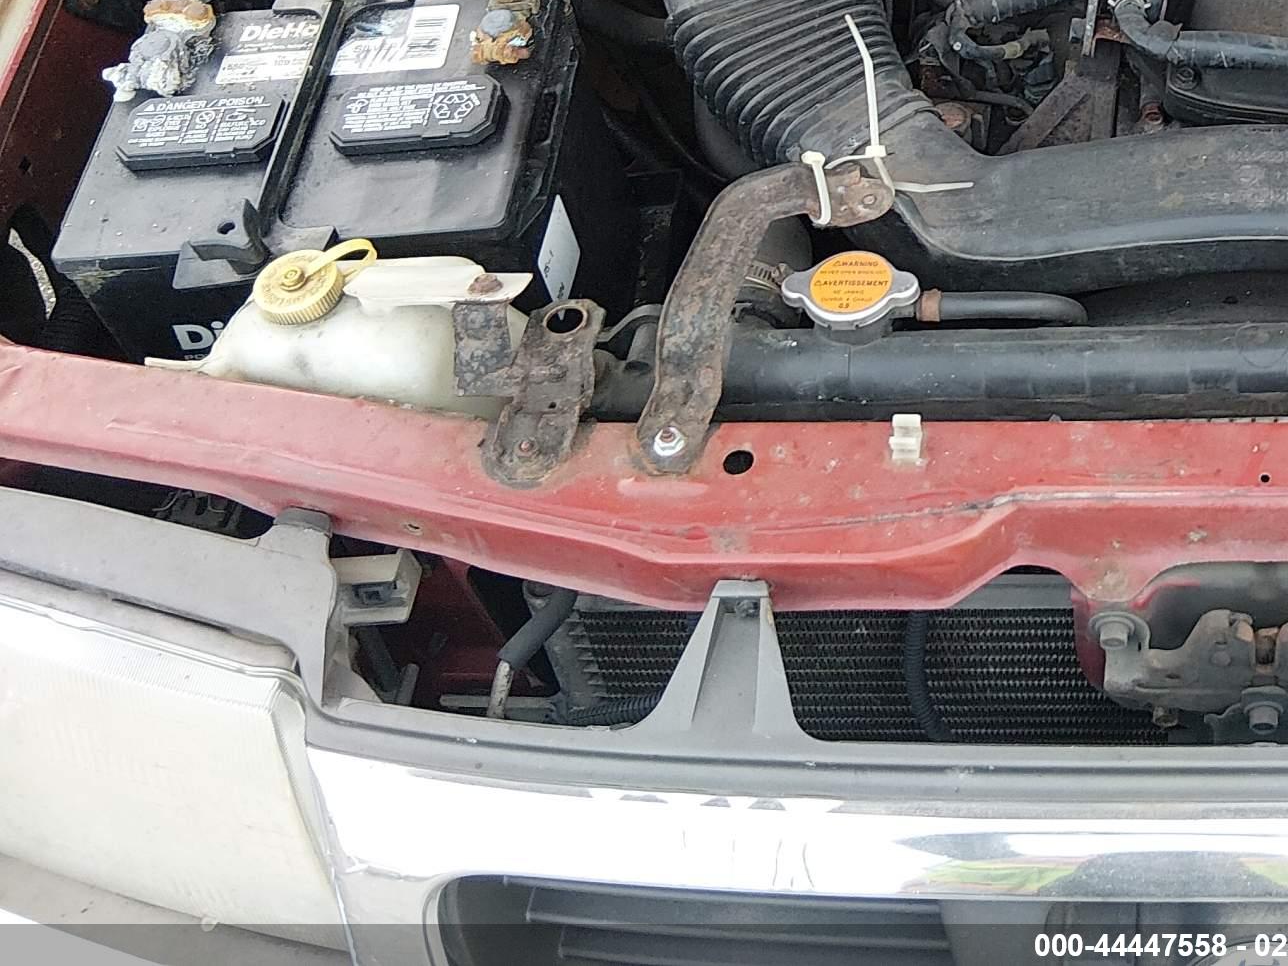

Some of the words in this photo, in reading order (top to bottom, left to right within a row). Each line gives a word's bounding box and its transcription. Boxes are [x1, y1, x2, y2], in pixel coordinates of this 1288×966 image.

[156, 100, 206, 112] DANGER
[217, 96, 264, 107] POISON
[822, 279, 889, 287] AVERTISSEMENT
